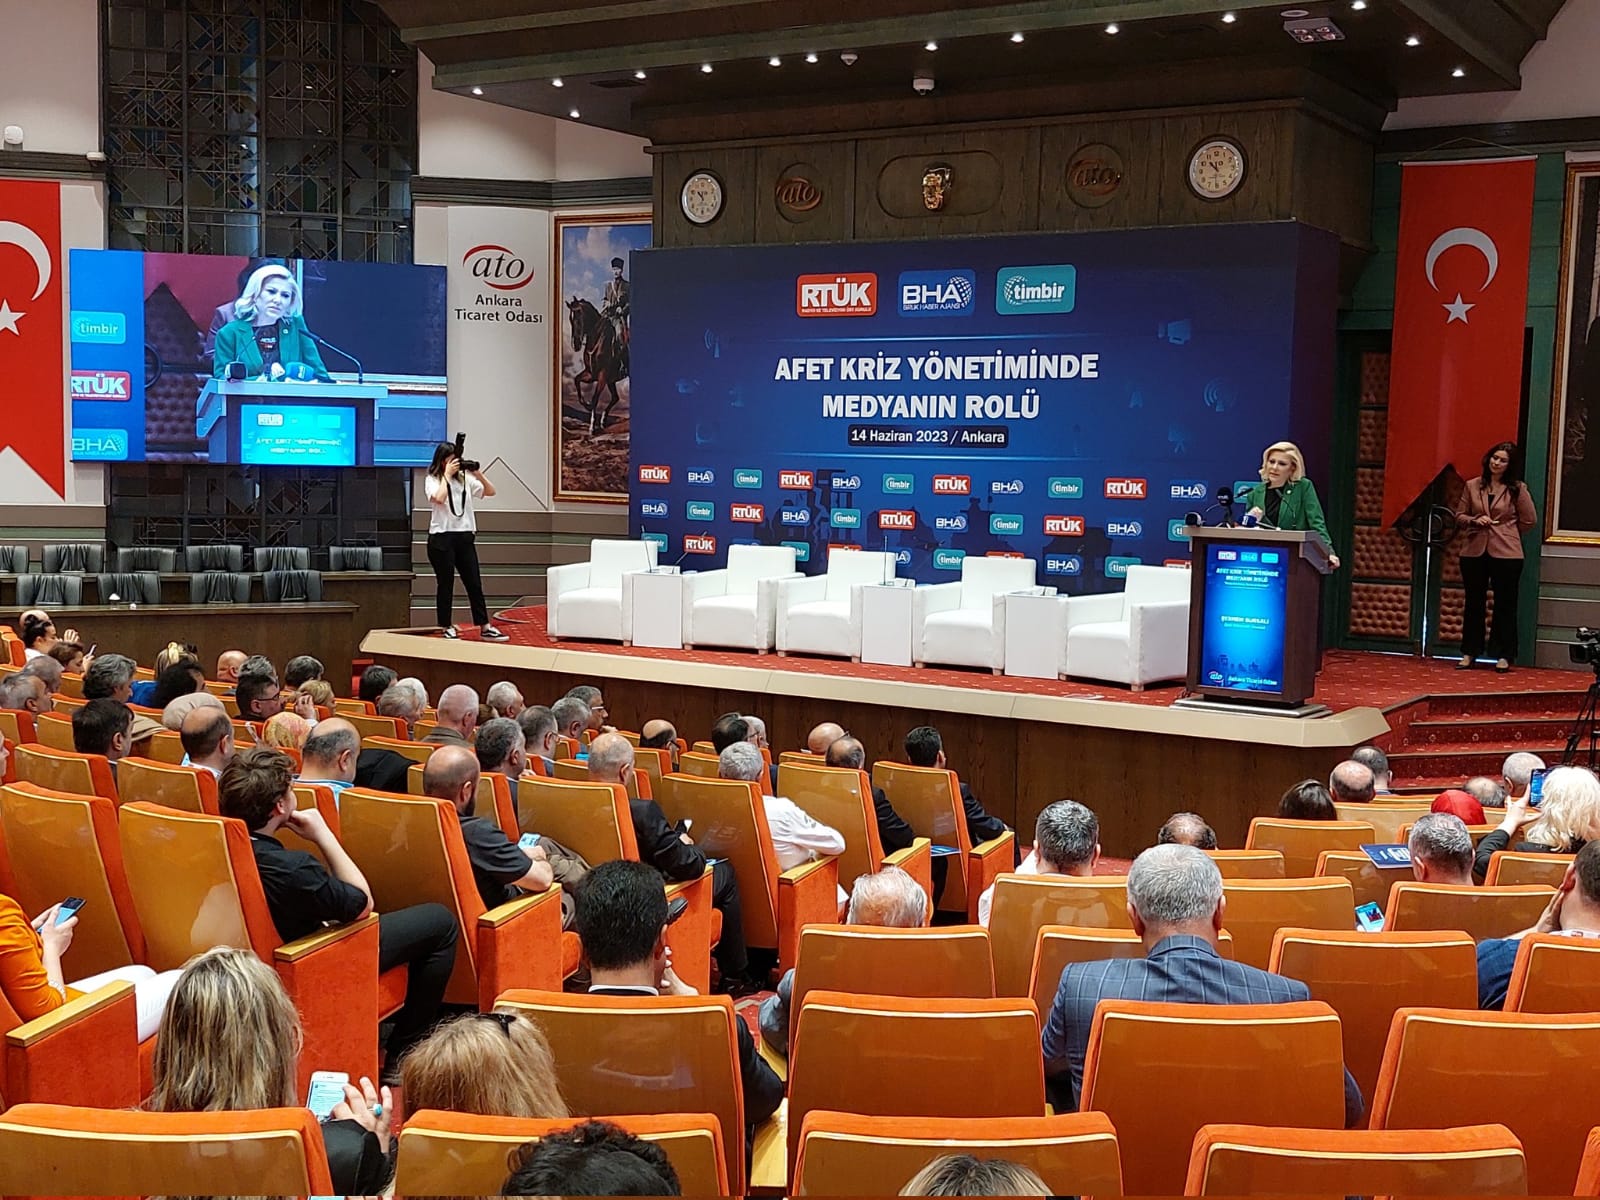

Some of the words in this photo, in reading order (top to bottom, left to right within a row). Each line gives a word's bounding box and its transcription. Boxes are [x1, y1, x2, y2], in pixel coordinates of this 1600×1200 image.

[472, 253, 525, 279] ato
[801, 277, 871, 308] RTÜK
[902, 284, 962, 304] BHA
[1014, 282, 1065, 300] timbir
[475, 294, 522, 307] Ankara
[454, 308, 500, 321] Ticaret
[506, 310, 543, 323] Odası
[80, 323, 118, 334] timbir
[774, 358, 834, 380] AFET
[840, 352, 901, 380] KRİZ
[908, 348, 1099, 380] YÖNETİMİNDE
[71, 373, 126, 394] RTÜK
[822, 395, 956, 419] MEDYANIN
[965, 388, 1040, 419] ROLÜ
[851, 430, 867, 441] 14
[870, 430, 912, 442] Haziran
[916, 430, 948, 442] 2023
[961, 430, 1005, 443] Ankara
[72, 438, 118, 451] BHA
[640, 467, 668, 480] RTÜK
[688, 472, 710, 480] BHA
[781, 472, 810, 485] RTÜK
[832, 478, 857, 486] BHA
[934, 476, 968, 490] RTÜK
[992, 482, 1019, 491] BHA
[1106, 480, 1143, 495] RTÜK
[1171, 486, 1201, 495] BHA
[642, 504, 664, 513] BHA
[732, 506, 760, 518] RTÜK
[782, 512, 806, 520] BHA
[880, 512, 912, 525] RTÜK
[936, 518, 962, 527] BHA
[1046, 518, 1081, 532] RTÜK
[1108, 524, 1136, 532] BHA
[686, 538, 712, 550] RTÜK
[1047, 561, 1074, 570] BHA
